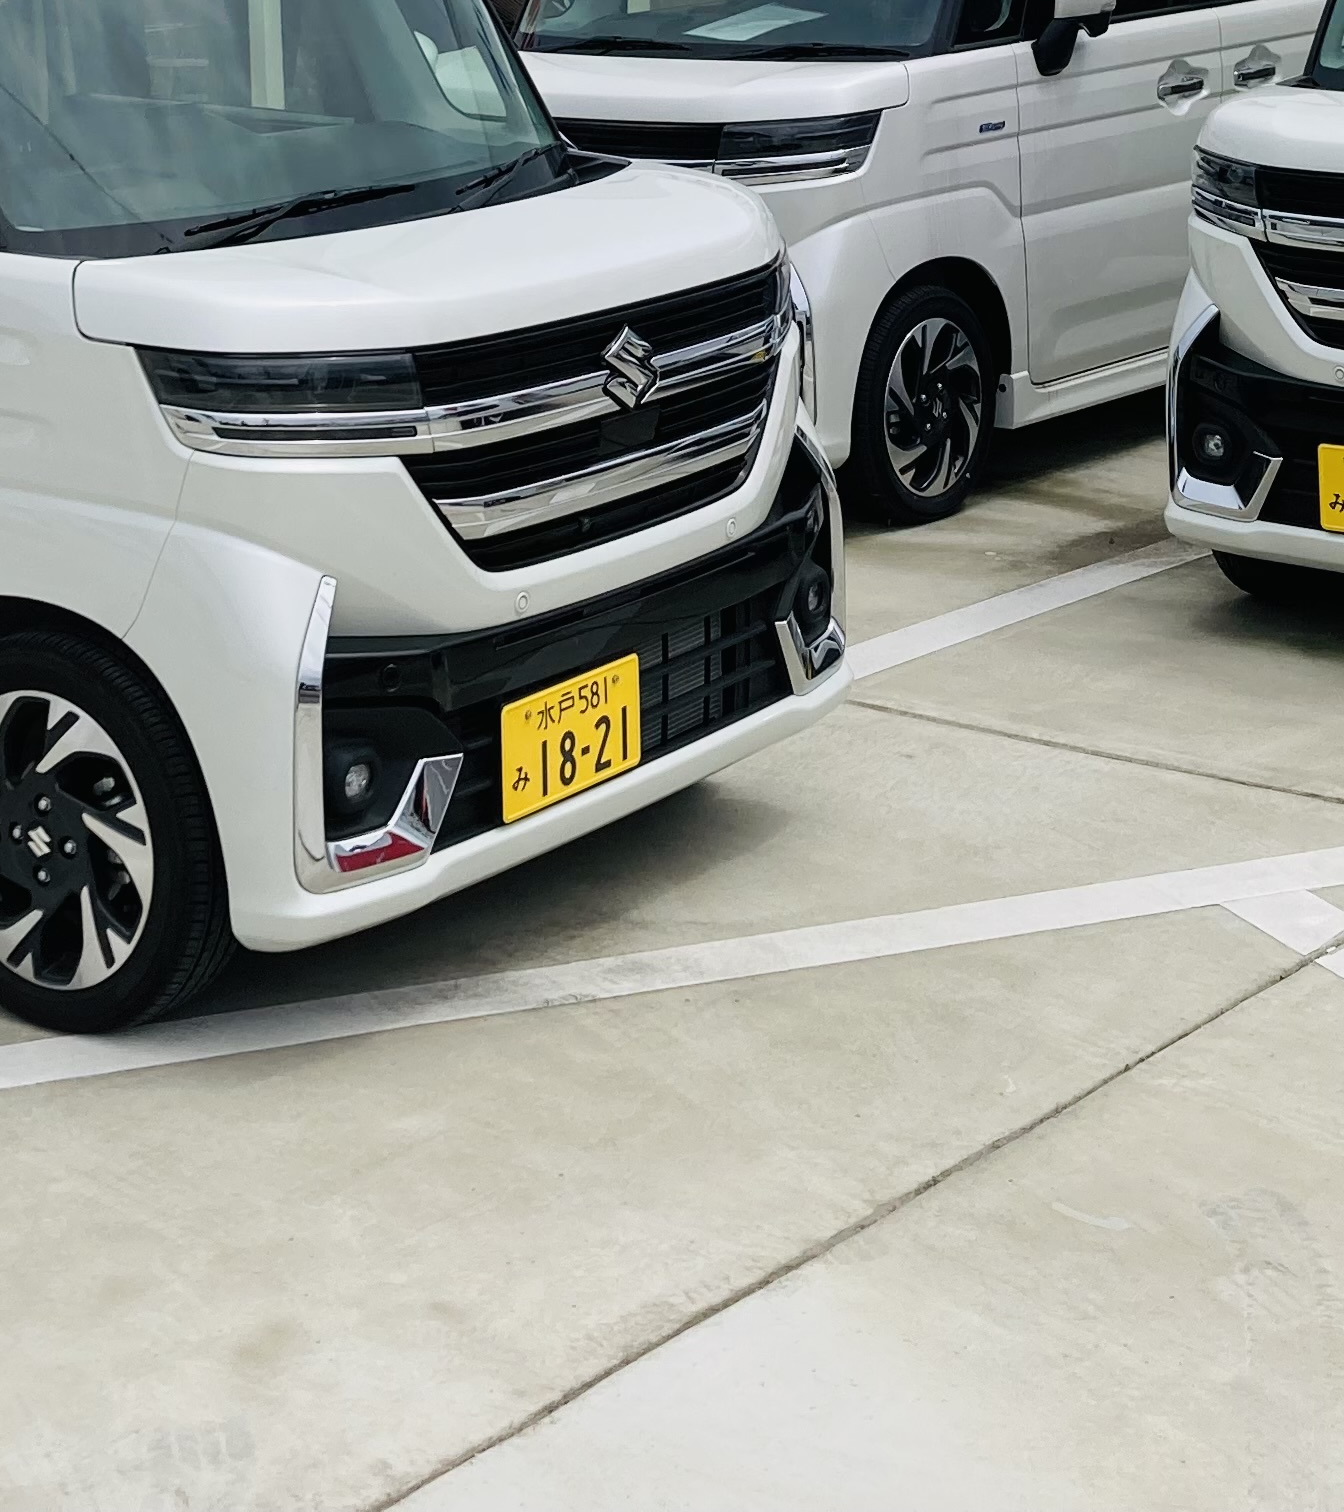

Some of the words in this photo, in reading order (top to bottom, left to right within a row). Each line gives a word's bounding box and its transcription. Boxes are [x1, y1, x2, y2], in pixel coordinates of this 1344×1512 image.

[536, 675, 608, 731] 水戸581
[511, 765, 531, 792] み
[541, 705, 628, 797] 18-21
